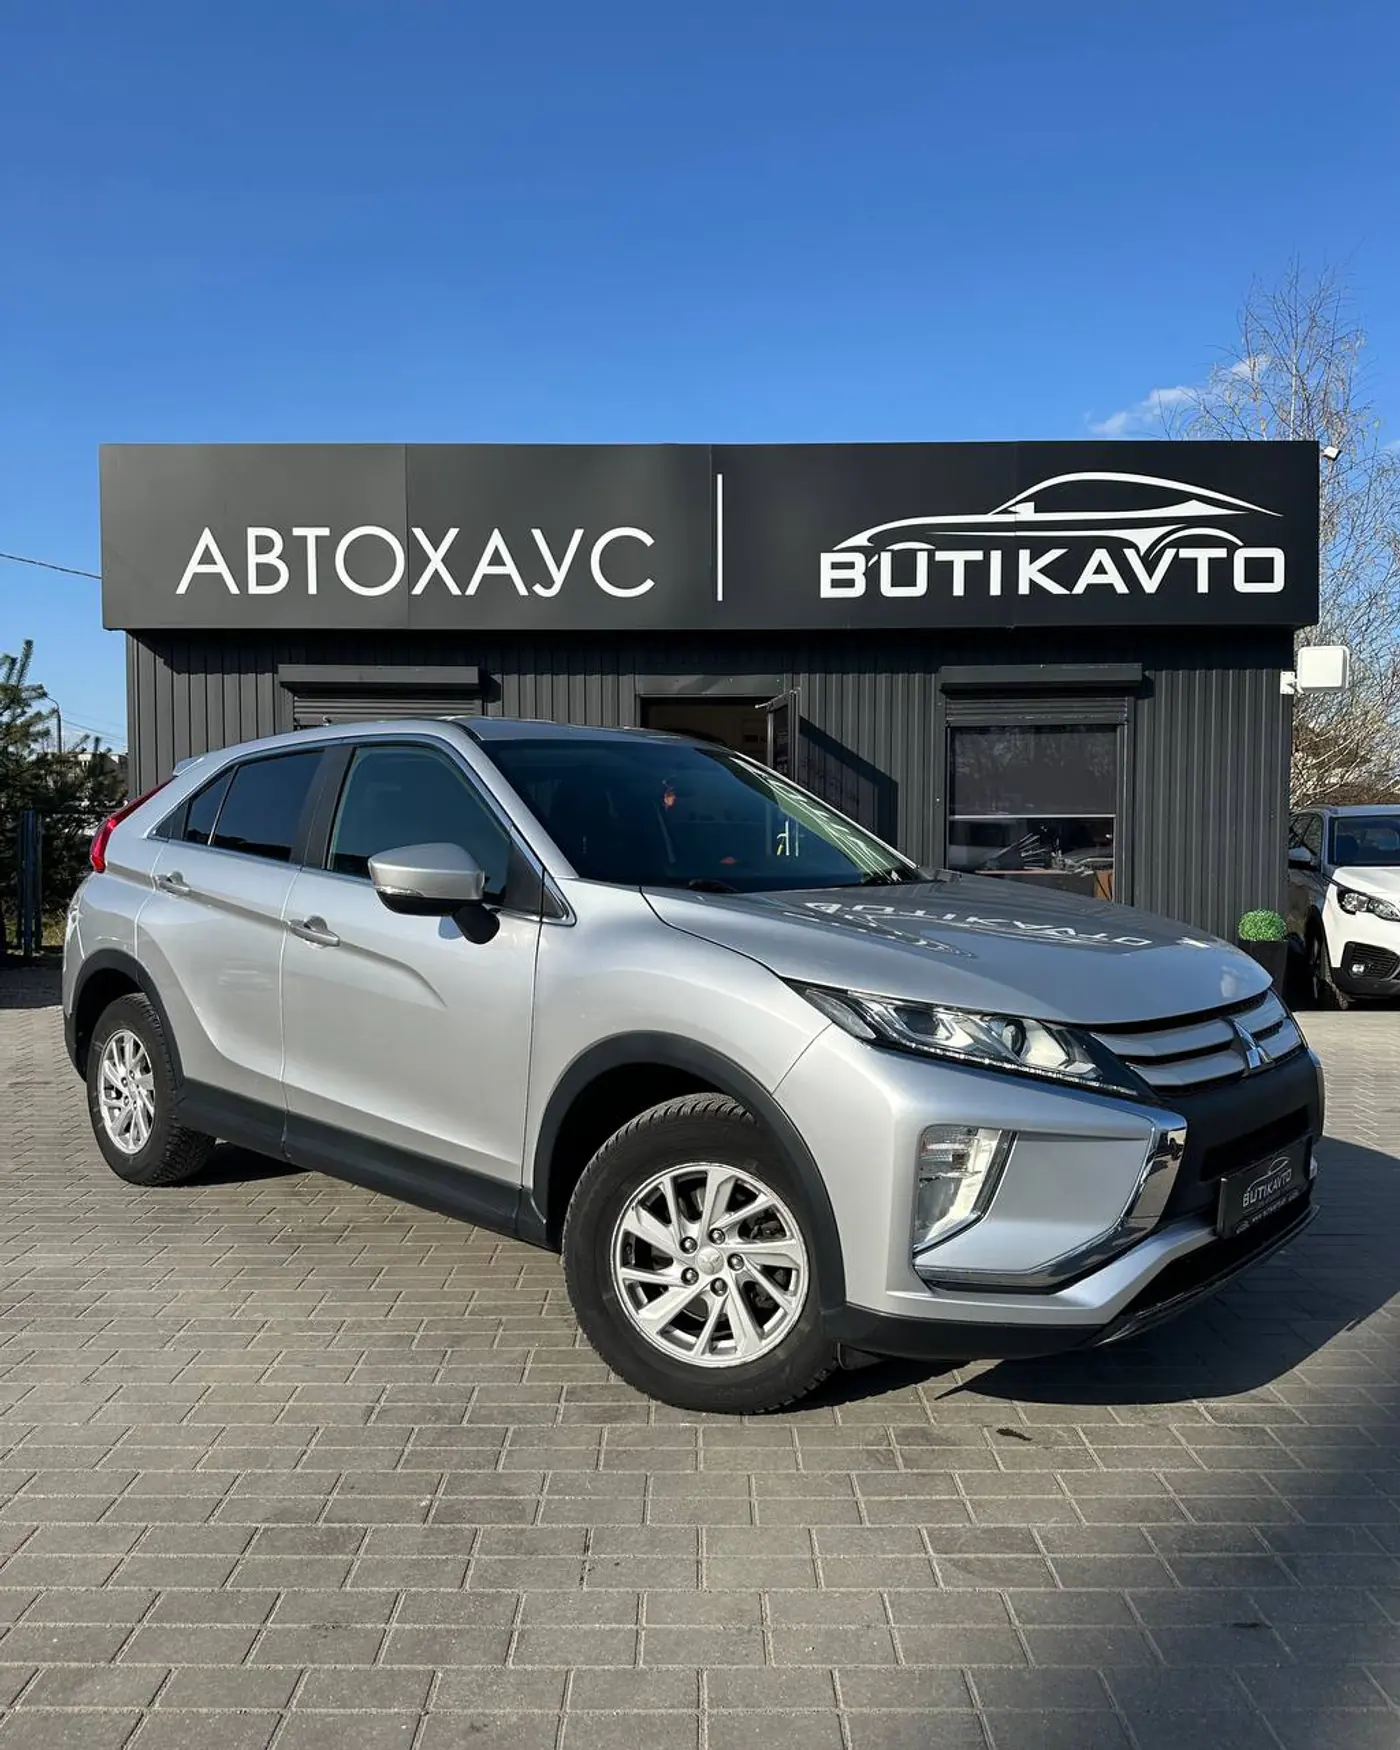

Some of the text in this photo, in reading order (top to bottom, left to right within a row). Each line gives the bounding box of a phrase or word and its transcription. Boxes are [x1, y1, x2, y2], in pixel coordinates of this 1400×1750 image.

[175, 525, 656, 598] АВТОХАУС
[819, 546, 1285, 599] BUTIKAVTO
[1242, 1168, 1292, 1207] BUTIKAVTO
